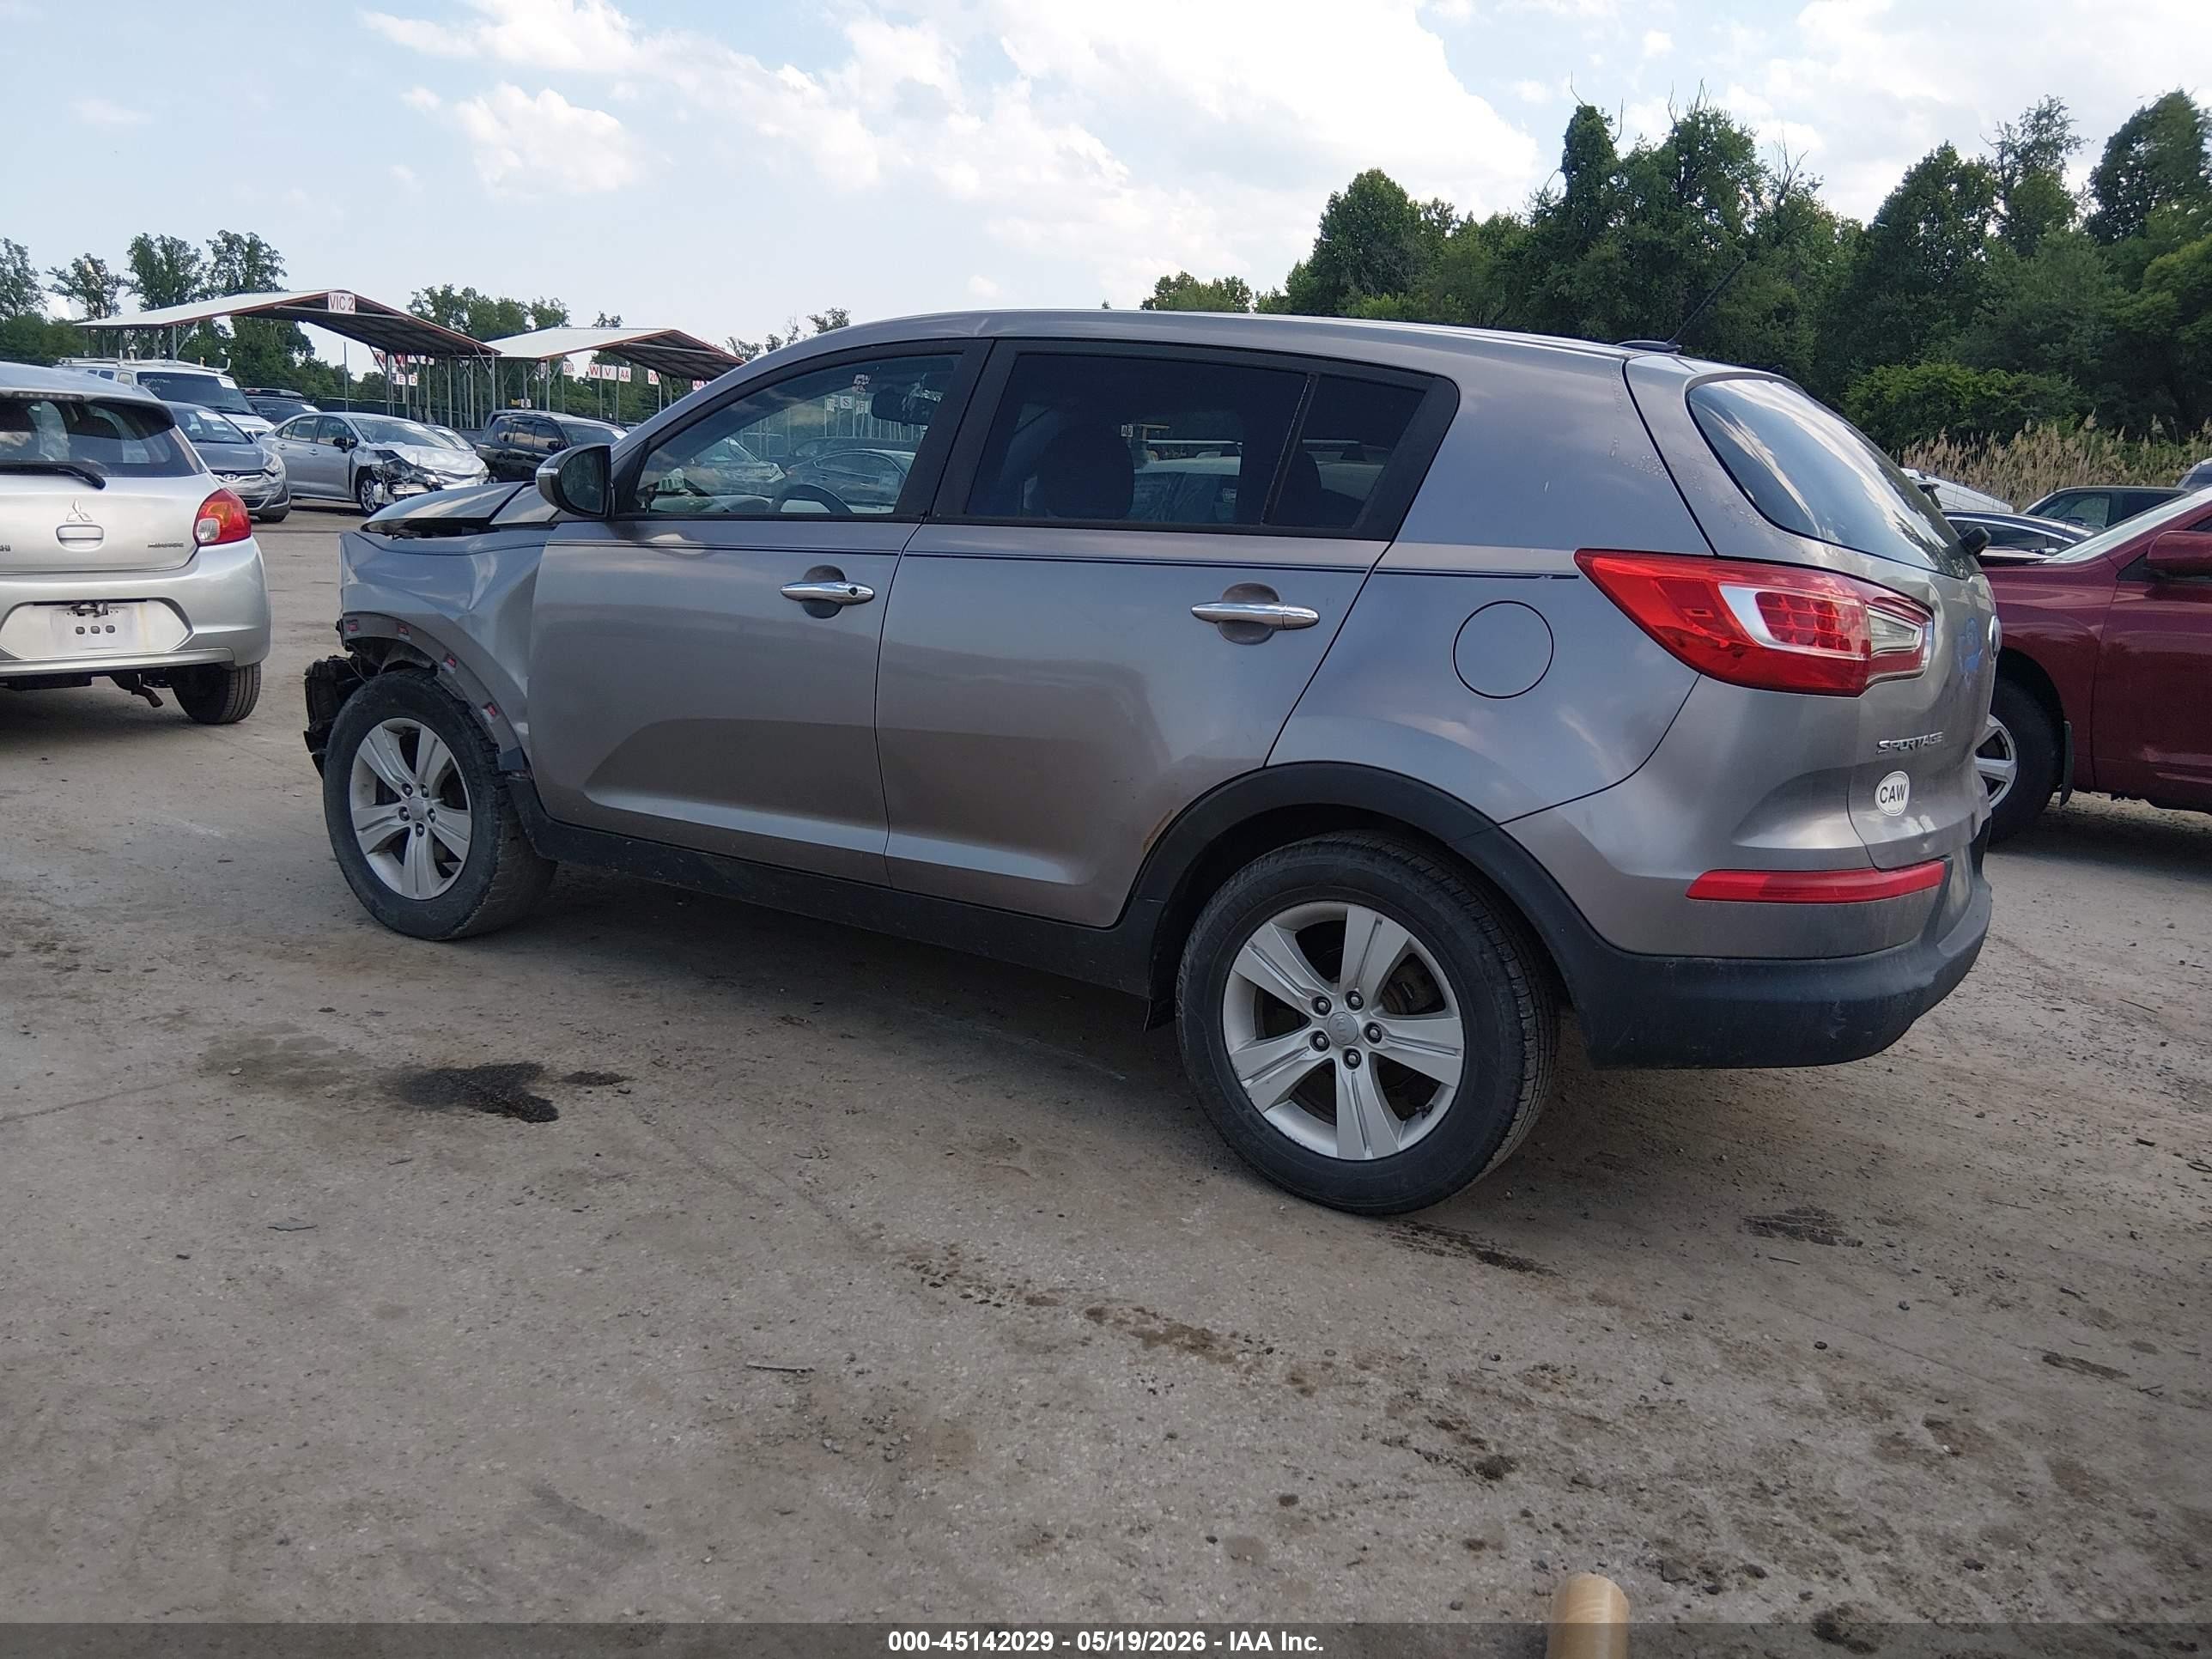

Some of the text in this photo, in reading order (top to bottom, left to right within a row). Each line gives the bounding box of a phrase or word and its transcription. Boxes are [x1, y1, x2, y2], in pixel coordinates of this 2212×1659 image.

[329, 295, 355, 311] VIC 2
[589, 366, 599, 376] W
[620, 371, 629, 380] AA
[1876, 732, 1944, 755] SPORTAGE
[1880, 783, 1906, 805] CAW
